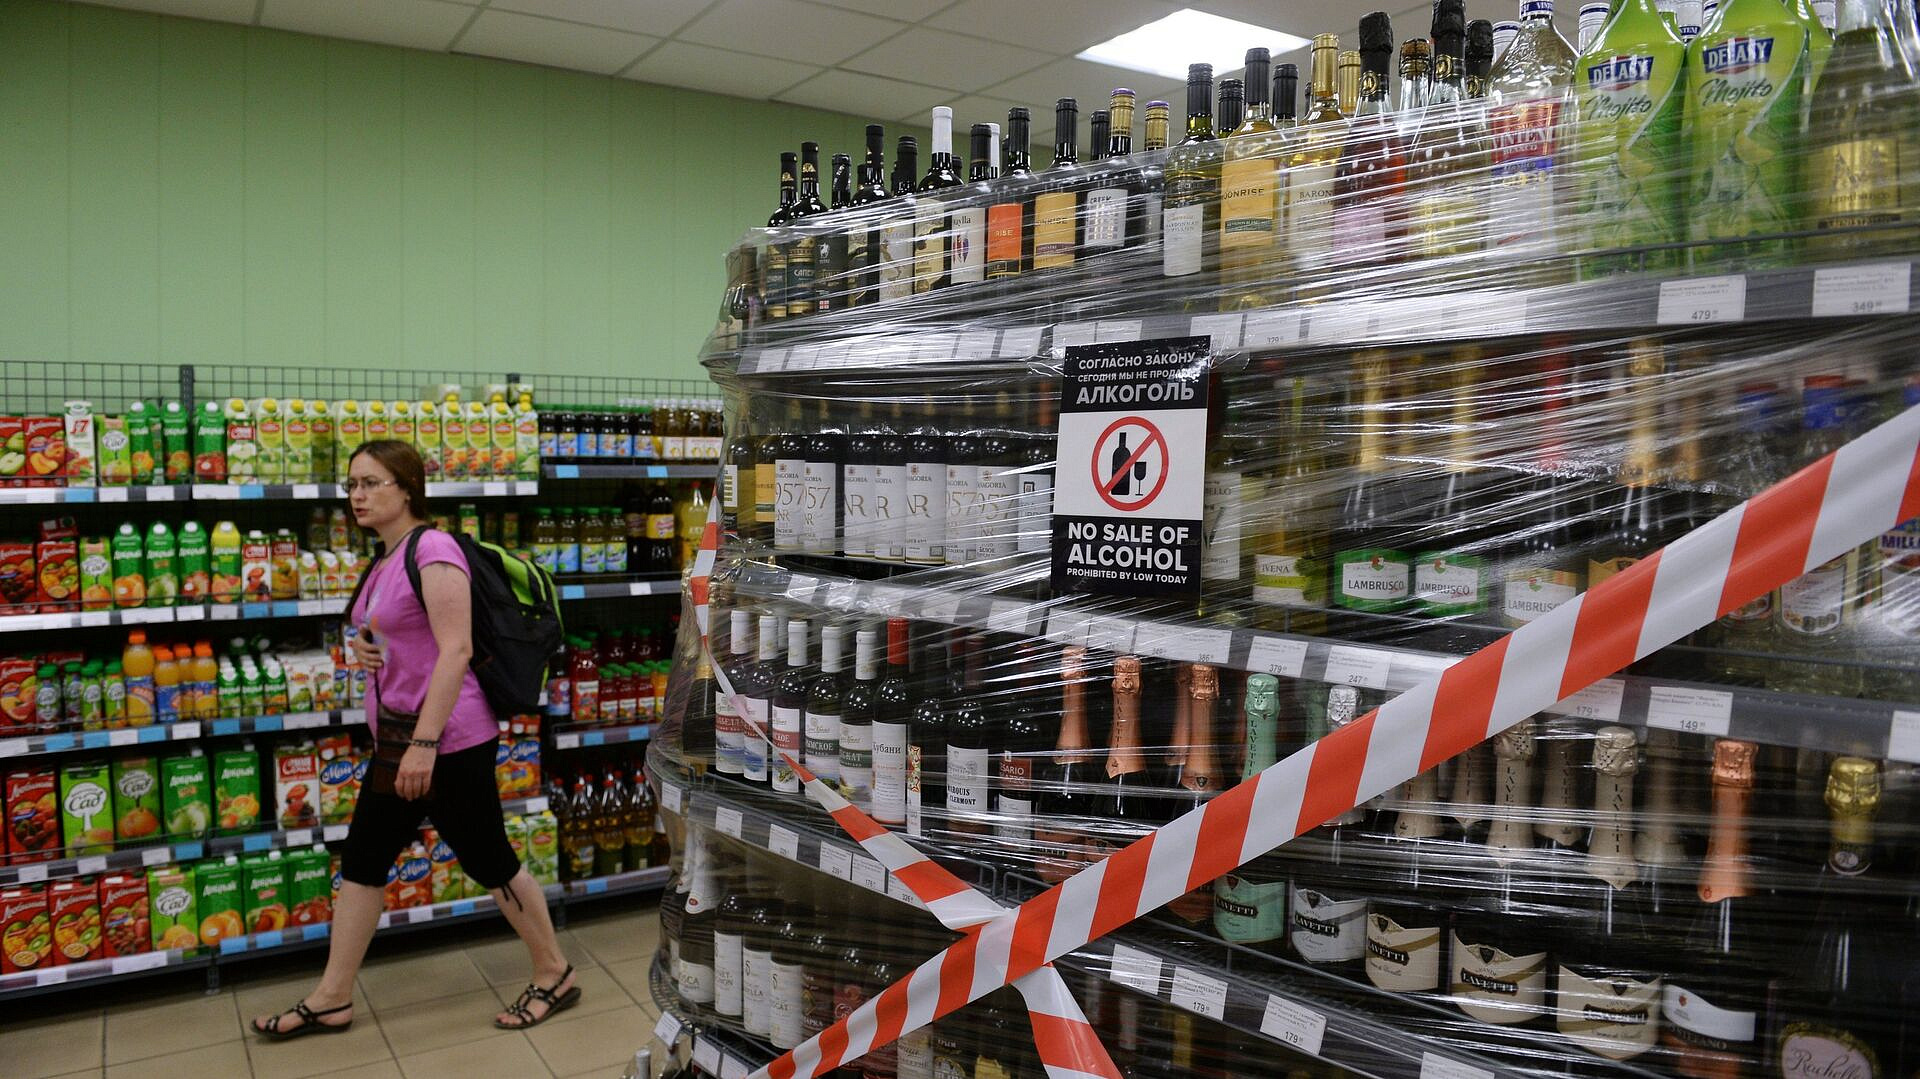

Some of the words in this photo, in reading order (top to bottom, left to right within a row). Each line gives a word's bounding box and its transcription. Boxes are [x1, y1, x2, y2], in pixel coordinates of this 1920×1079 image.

[1699, 78, 1774, 106] Mojito
[1586, 94, 1652, 122] Mojito
[1691, 310, 1711, 320] 479
[1078, 356, 1142, 370] СОГЛАСНО
[1145, 352, 1196, 365] ЗАКОНУ
[1077, 373, 1117, 383] СЕГОДНЯ
[1119, 371, 1134, 381] МЫ
[1136, 371, 1148, 380] НЕ
[1076, 382, 1195, 405] АЛКОГОЛЬ
[1068, 522, 1098, 540] NO
[1102, 523, 1153, 543] SALE
[1160, 526, 1189, 545] OF
[1067, 543, 1188, 572] ALCOHOL
[1066, 567, 1118, 579] PROHIBITED
[1120, 572, 1132, 580] BY
[1133, 572, 1154, 582] LOW
[1155, 574, 1188, 584] TODAY
[1348, 579, 1404, 592] LAMBRUSCO
[1417, 582, 1470, 596] LAMBRUSCO
[1269, 663, 1283, 674] 379
[1349, 675, 1362, 685] 247
[1576, 706, 1593, 717] 179
[1680, 720, 1698, 731] 149
[1193, 1001, 1206, 1013] 179
[1284, 1031, 1299, 1044] 179
